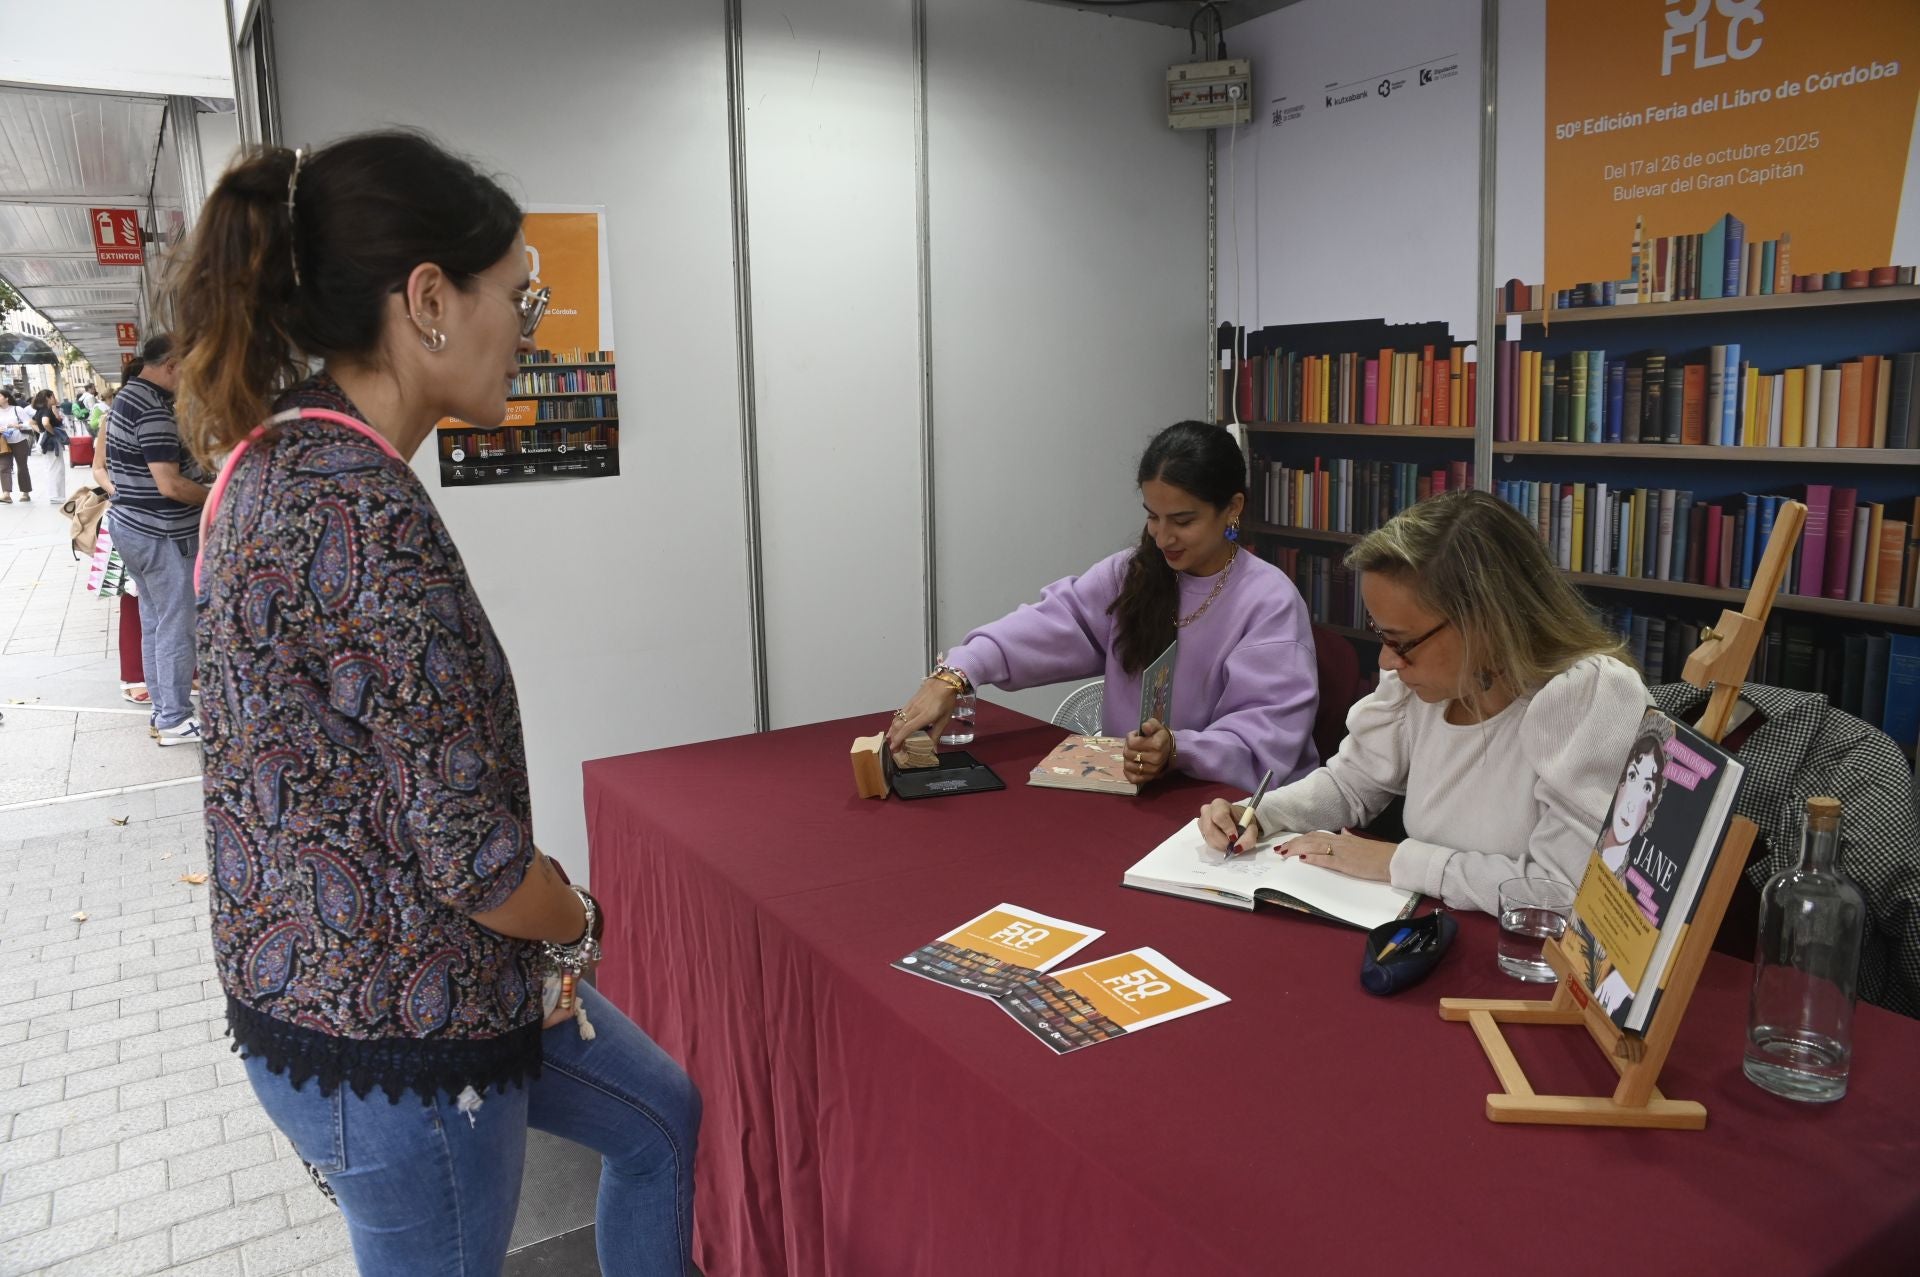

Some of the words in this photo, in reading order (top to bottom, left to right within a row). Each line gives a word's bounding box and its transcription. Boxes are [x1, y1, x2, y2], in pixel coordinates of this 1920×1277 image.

[1661, 16, 1764, 76] FLC
[1333, 90, 1368, 106] kutxabank
[1583, 112, 1642, 135] Edición
[1645, 102, 1688, 124] Feria
[1691, 95, 1718, 116] del
[1722, 88, 1771, 110] Libro
[1775, 80, 1800, 99] de
[1805, 60, 1899, 93] Córdoba
[1604, 163, 1626, 180] Del
[1630, 160, 1643, 176] 17
[1645, 158, 1658, 174] al
[1661, 155, 1680, 172] 26
[1683, 152, 1702, 168] de
[1706, 142, 1771, 166] octubre
[1775, 131, 1820, 155] 2025
[1613, 182, 1668, 201] Bulevar
[1671, 176, 1693, 194] del
[1697, 173, 1734, 190] Gran
[1738, 161, 1804, 186] Capitán
[100, 252, 140, 260] EXTINTOR
[1633, 837, 1678, 892] JANE
[1103, 976, 1139, 1002] FLC
[1122, 968, 1172, 999] 50
